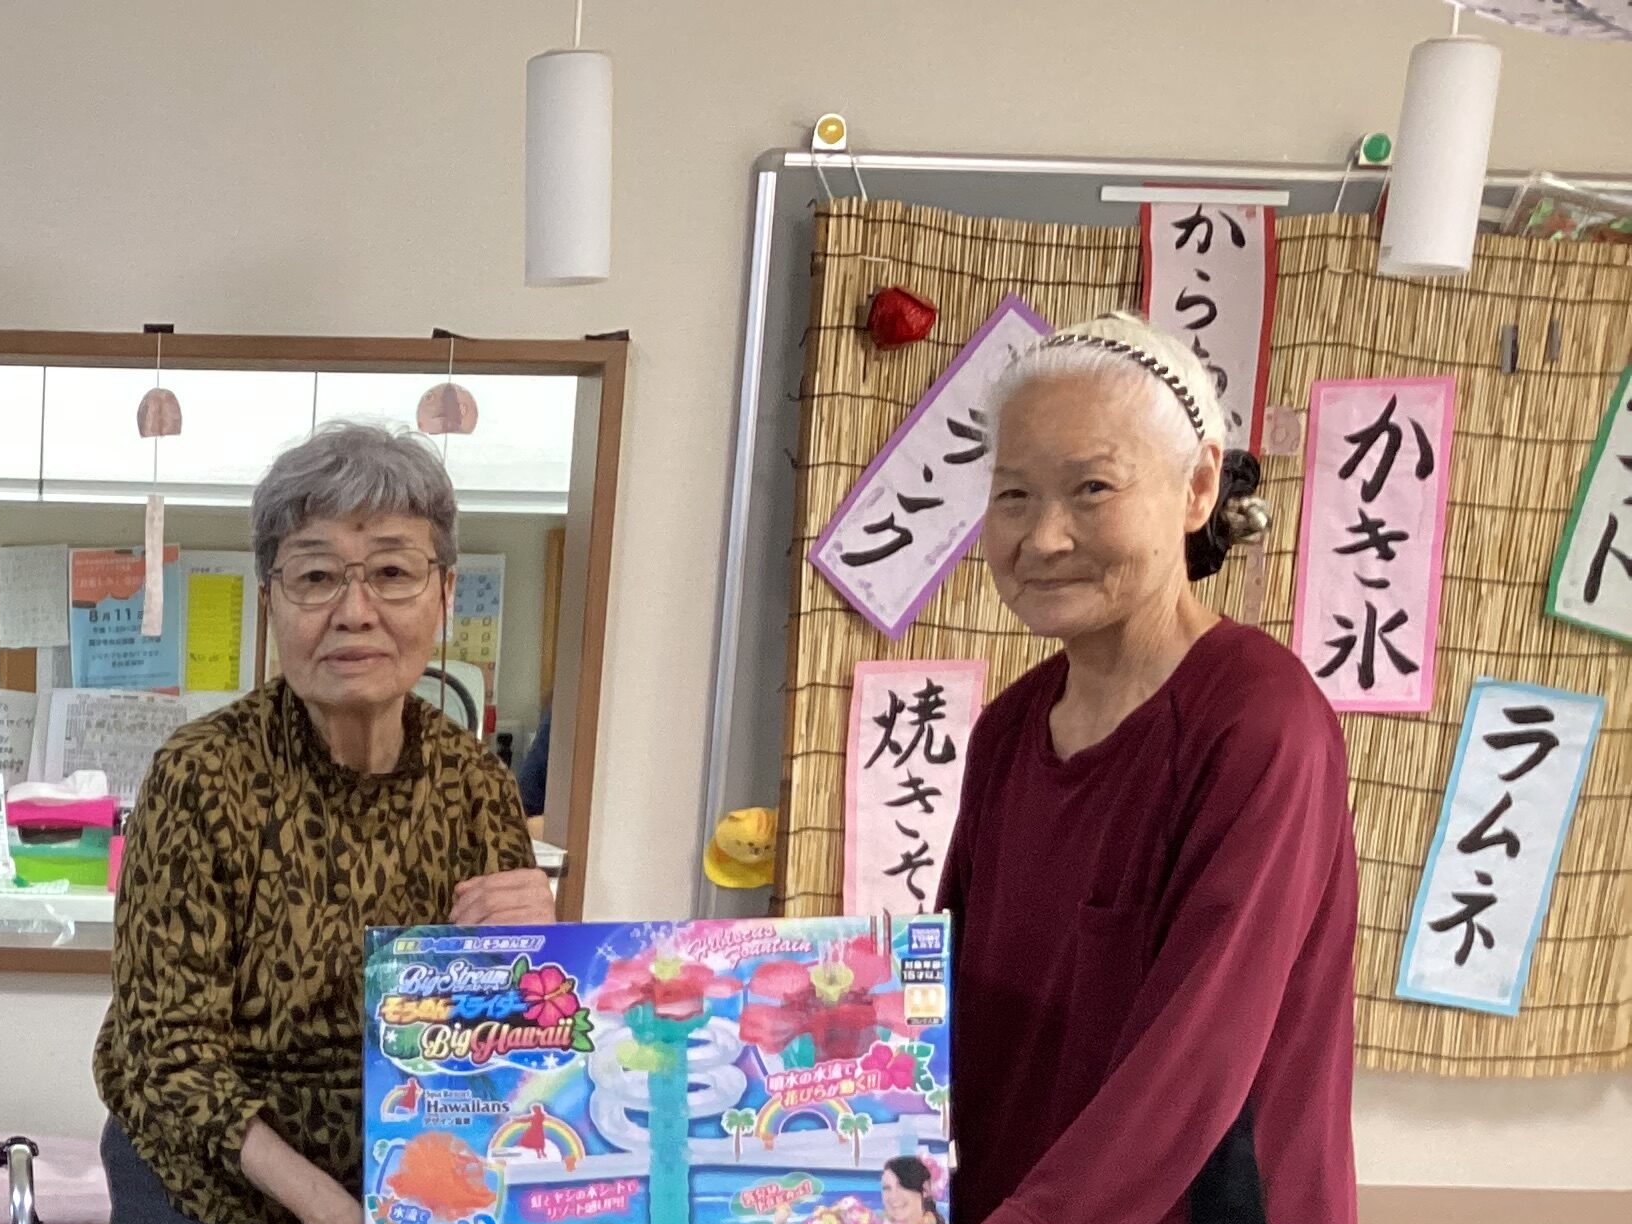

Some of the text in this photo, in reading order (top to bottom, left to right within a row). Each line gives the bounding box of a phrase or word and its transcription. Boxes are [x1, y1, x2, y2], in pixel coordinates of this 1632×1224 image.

[1316, 394, 1434, 690] かき氷
[864, 677, 956, 914] 焼きそ
[1427, 705, 1560, 967] ラムネ
[399, 964, 436, 996] Big
[421, 1018, 573, 1064] Big Hawaii
